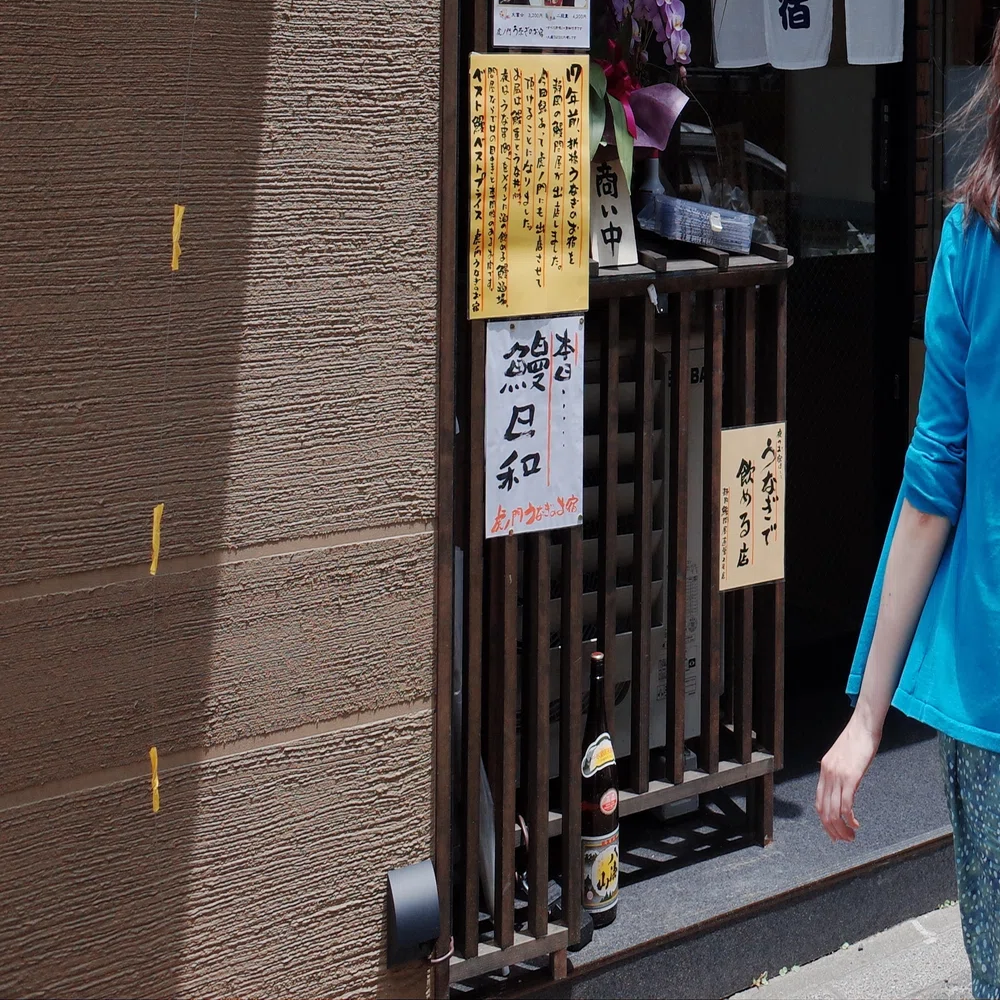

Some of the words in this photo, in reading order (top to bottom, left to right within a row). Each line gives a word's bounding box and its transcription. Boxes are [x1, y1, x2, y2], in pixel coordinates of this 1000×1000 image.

[595, 161, 623, 257] 商い中
[496, 330, 550, 491] 鰻日和
[736, 458, 756, 568] 飲める店
[761, 437, 780, 547] うなぎで
